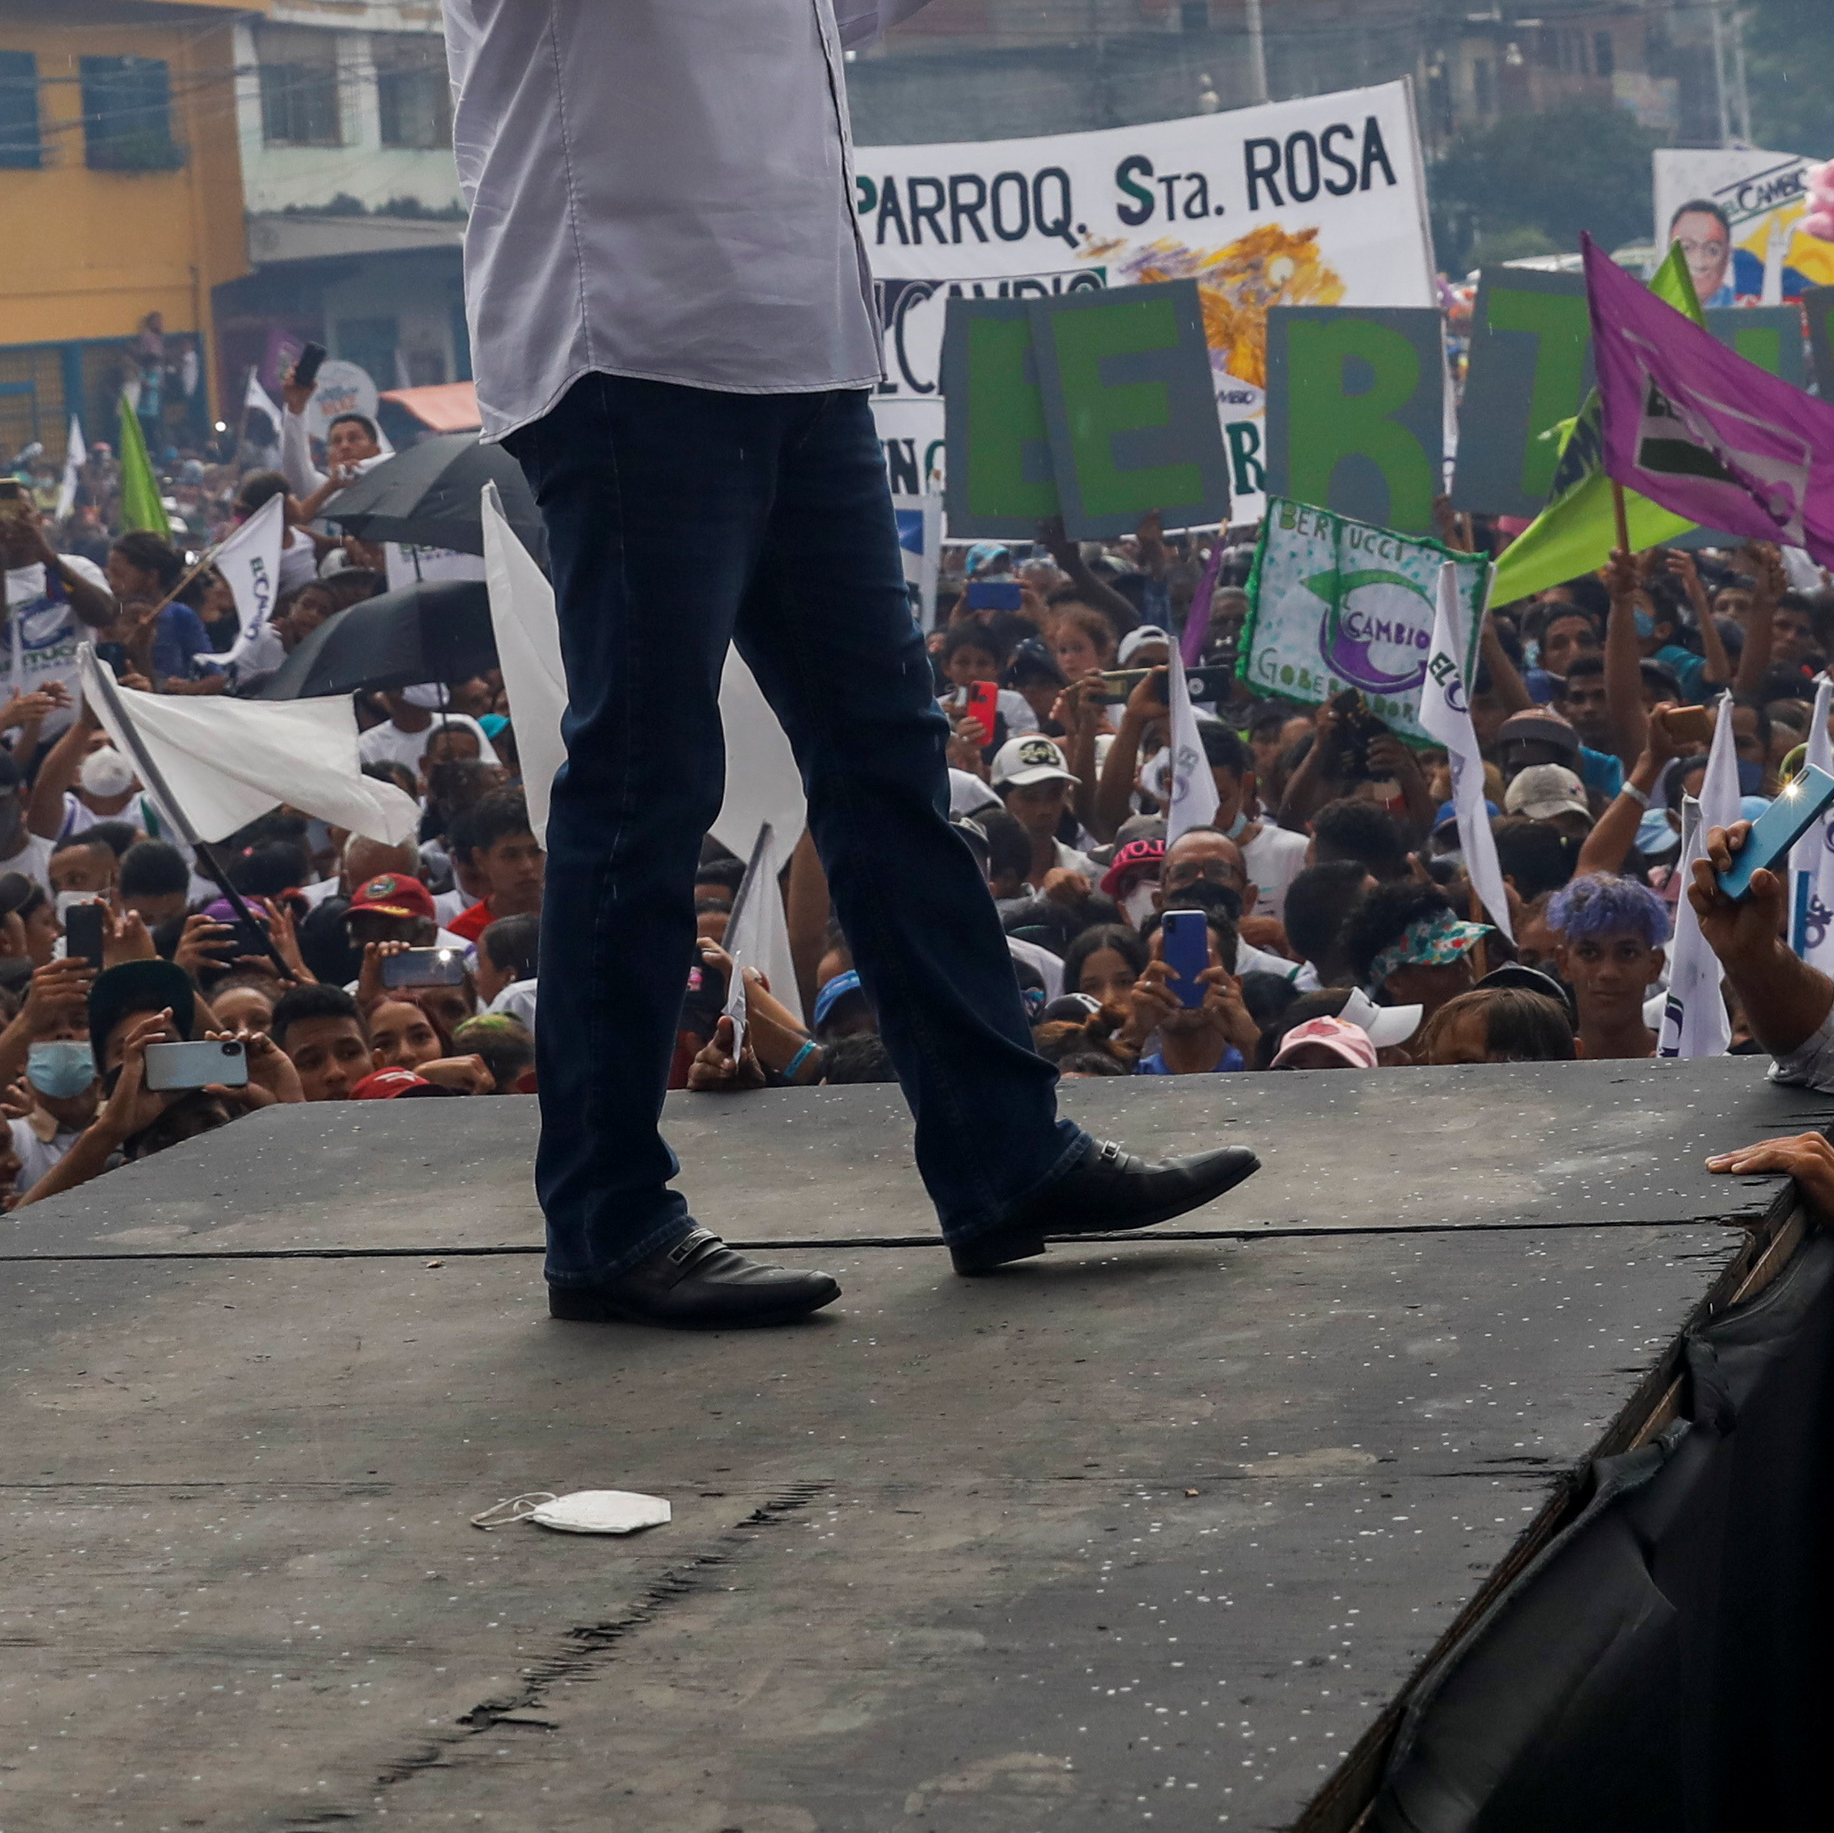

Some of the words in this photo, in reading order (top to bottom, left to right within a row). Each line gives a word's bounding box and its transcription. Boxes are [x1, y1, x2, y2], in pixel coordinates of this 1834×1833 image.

[1244, 116, 1397, 211] ROSA
[1345, 610, 1431, 650] CAMBIO
[1427, 650, 1458, 688] EL
